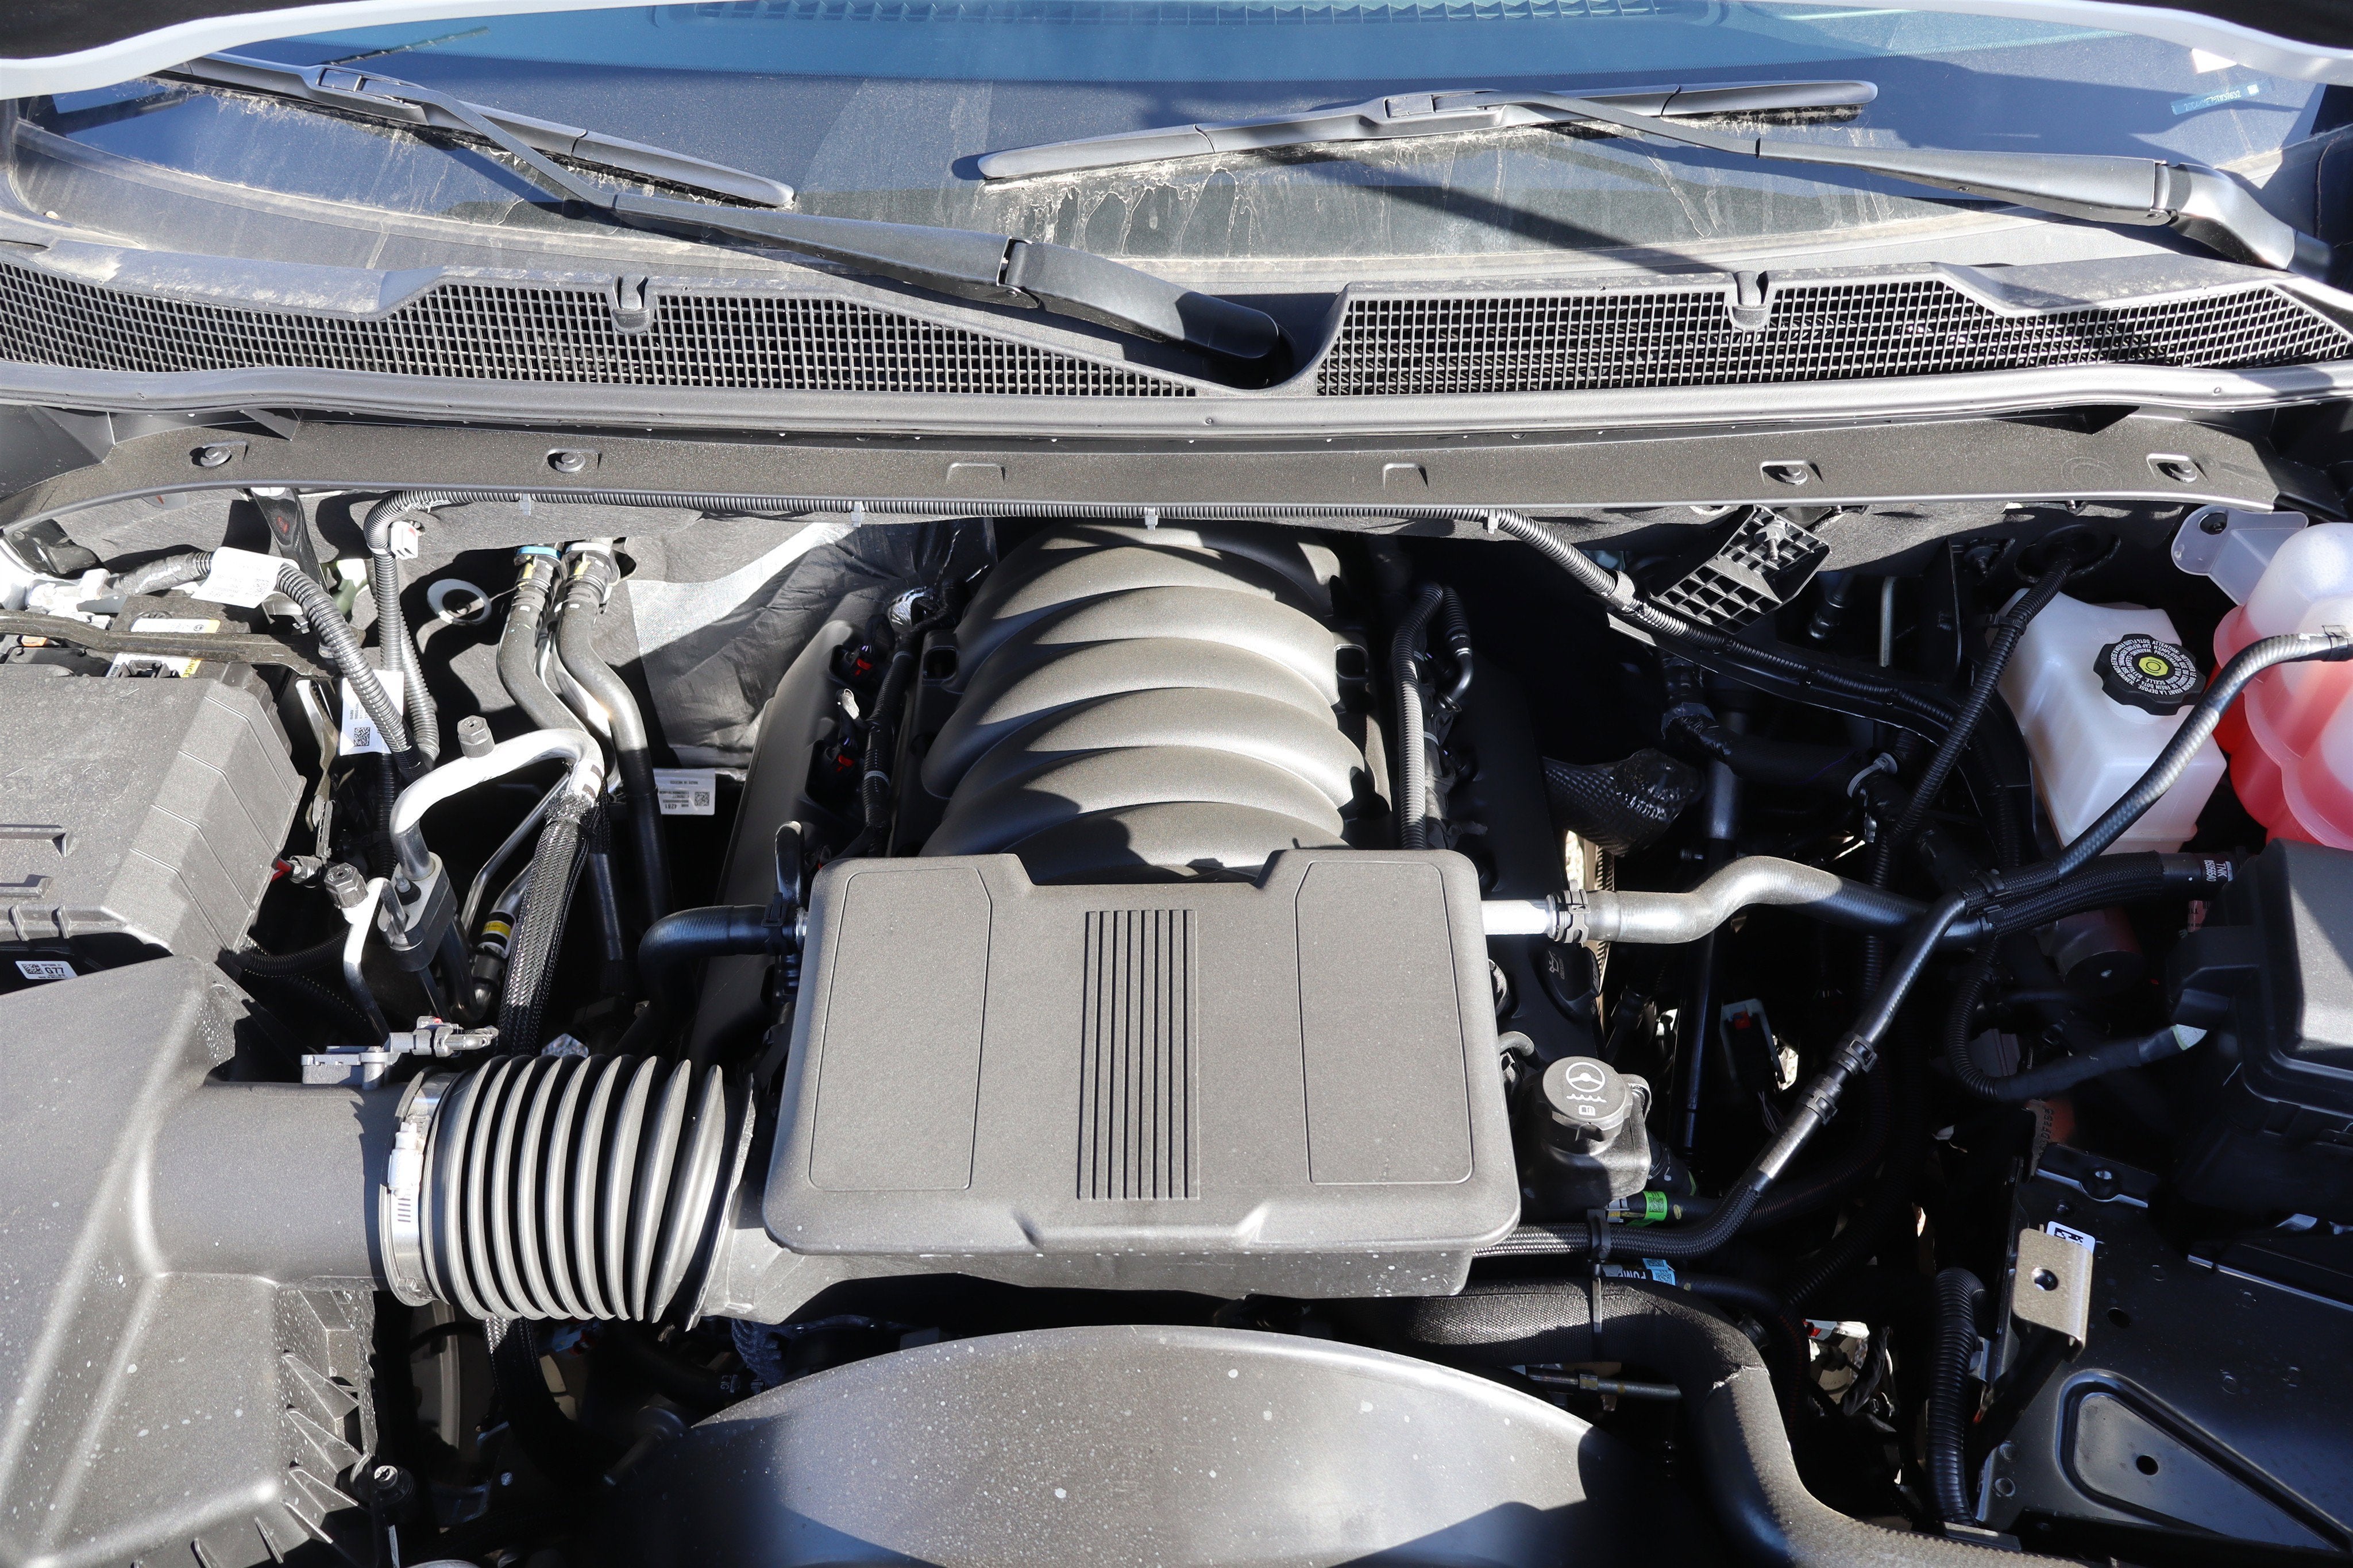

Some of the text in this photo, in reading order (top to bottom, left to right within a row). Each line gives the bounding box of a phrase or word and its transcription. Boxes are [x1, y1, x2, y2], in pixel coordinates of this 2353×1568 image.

[2113, 643, 2126, 652] FROM
[2152, 640, 2180, 655] ATTENTION:
[2153, 645, 2182, 662] N'EMPLOYER
[2154, 650, 2180, 667] PROVENANT
[2180, 654, 2196, 672] NETTOYER
[2113, 666, 2135, 686] CONTAINER.
[2127, 666, 2143, 679] FILLER
[2127, 673, 2140, 682] ONLY
[2141, 681, 2154, 689] DOT4
[2167, 688, 2183, 696] AVANT
[2216, 863, 2227, 878] TNK
